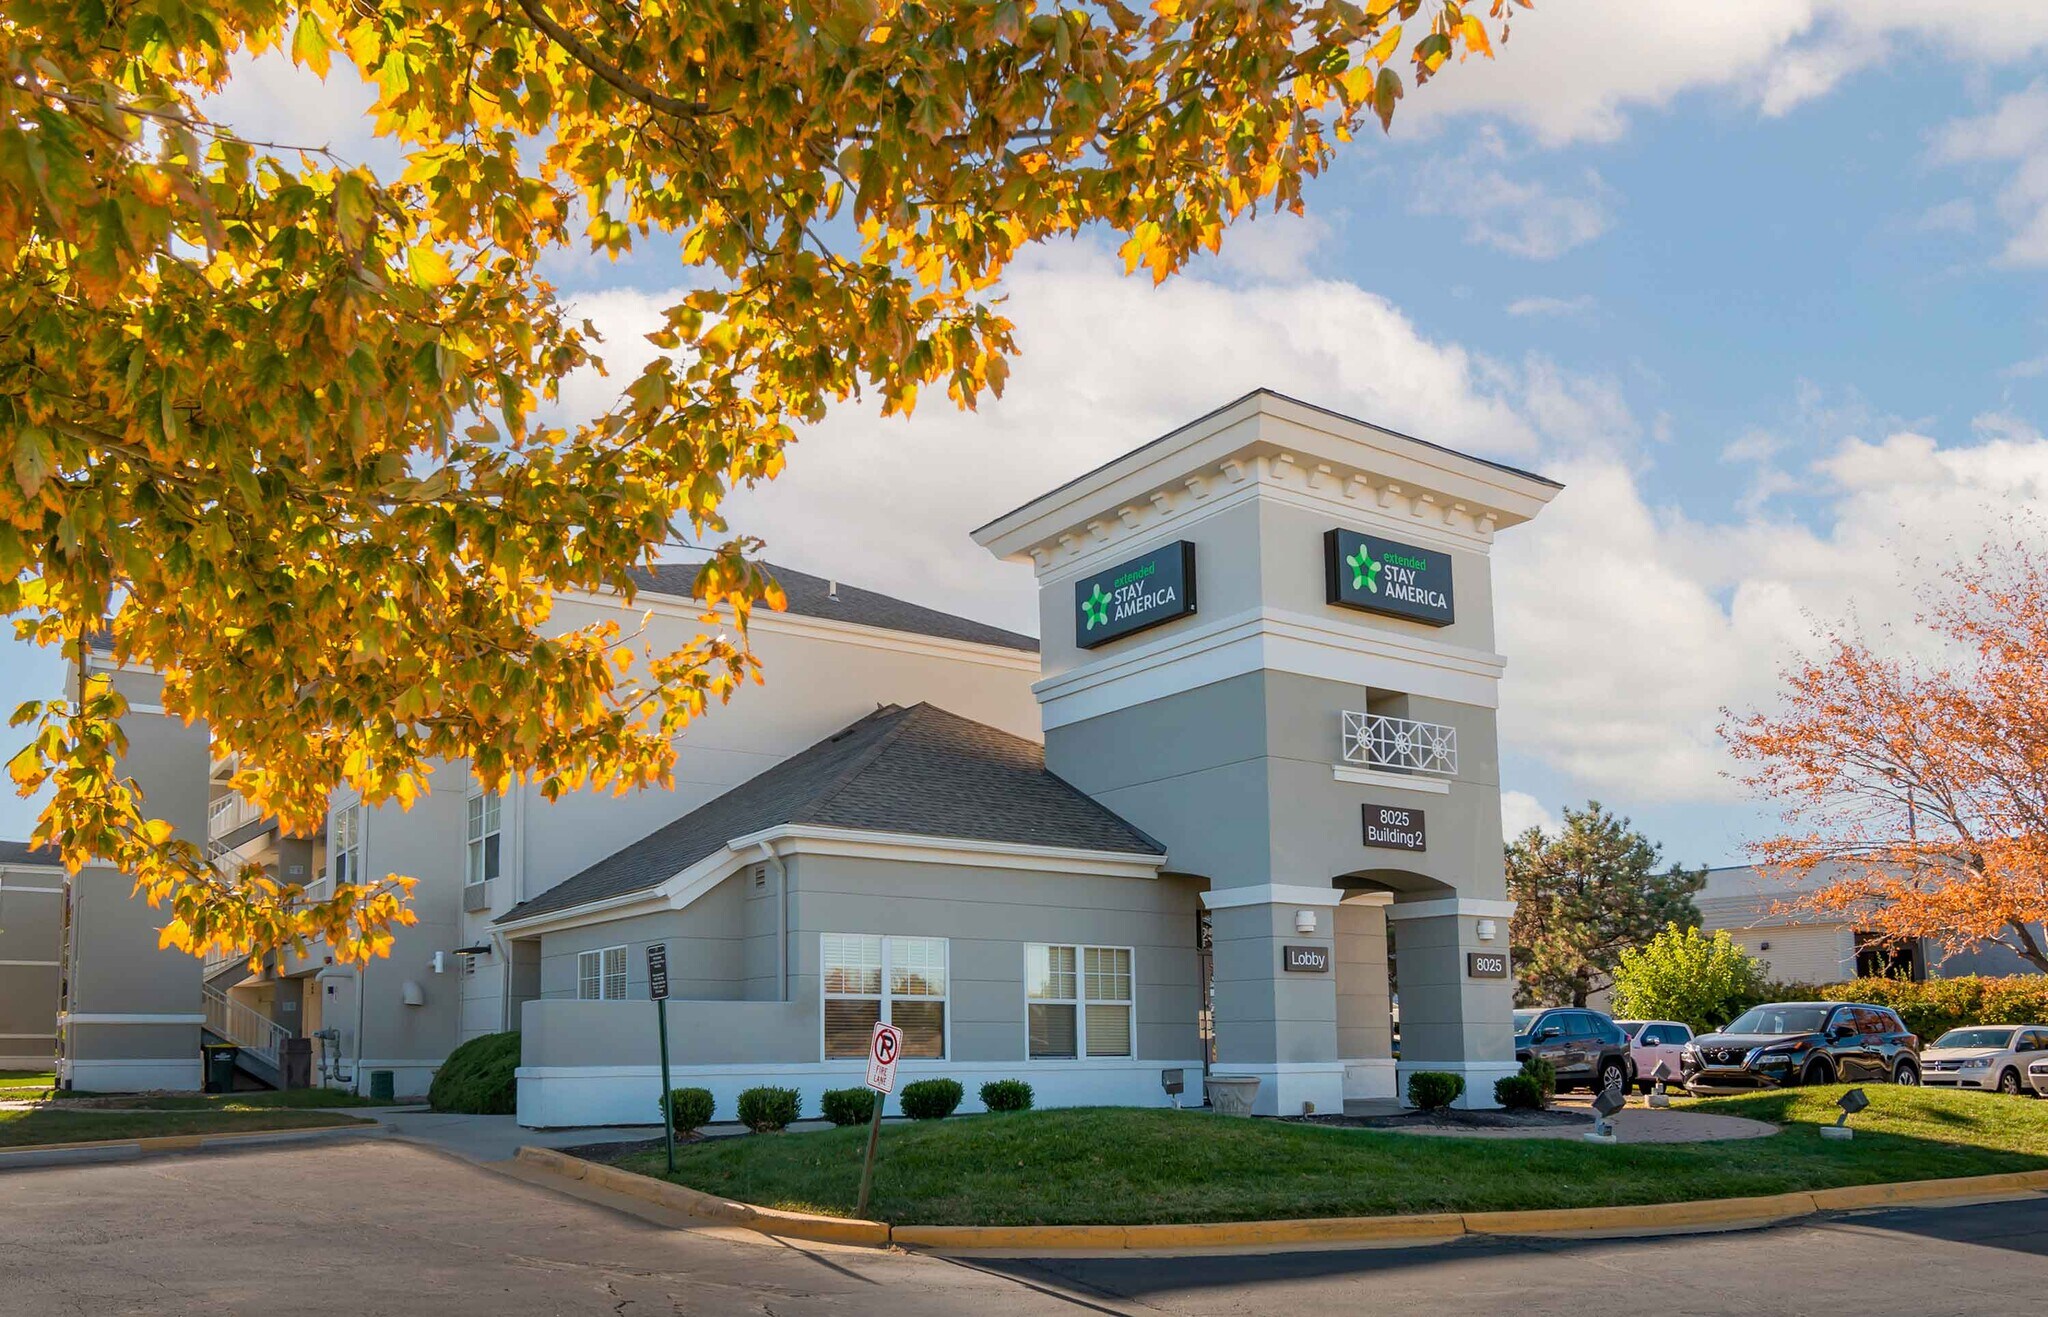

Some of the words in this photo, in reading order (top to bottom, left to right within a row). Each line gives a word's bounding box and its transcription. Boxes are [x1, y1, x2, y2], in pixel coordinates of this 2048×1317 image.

[1383, 552, 1426, 571] extended
[1114, 561, 1155, 588] extended
[1384, 564, 1416, 585] STAY
[1114, 579, 1145, 605] STAY
[1385, 581, 1447, 609] AMERICA
[1114, 586, 1176, 621] AMERICA
[1380, 809, 1410, 826] 8025
[1368, 825, 1414, 848] Building
[1415, 831, 1423, 845] 2
[1291, 951, 1326, 969] Lobby
[1476, 957, 1502, 972] 8025
